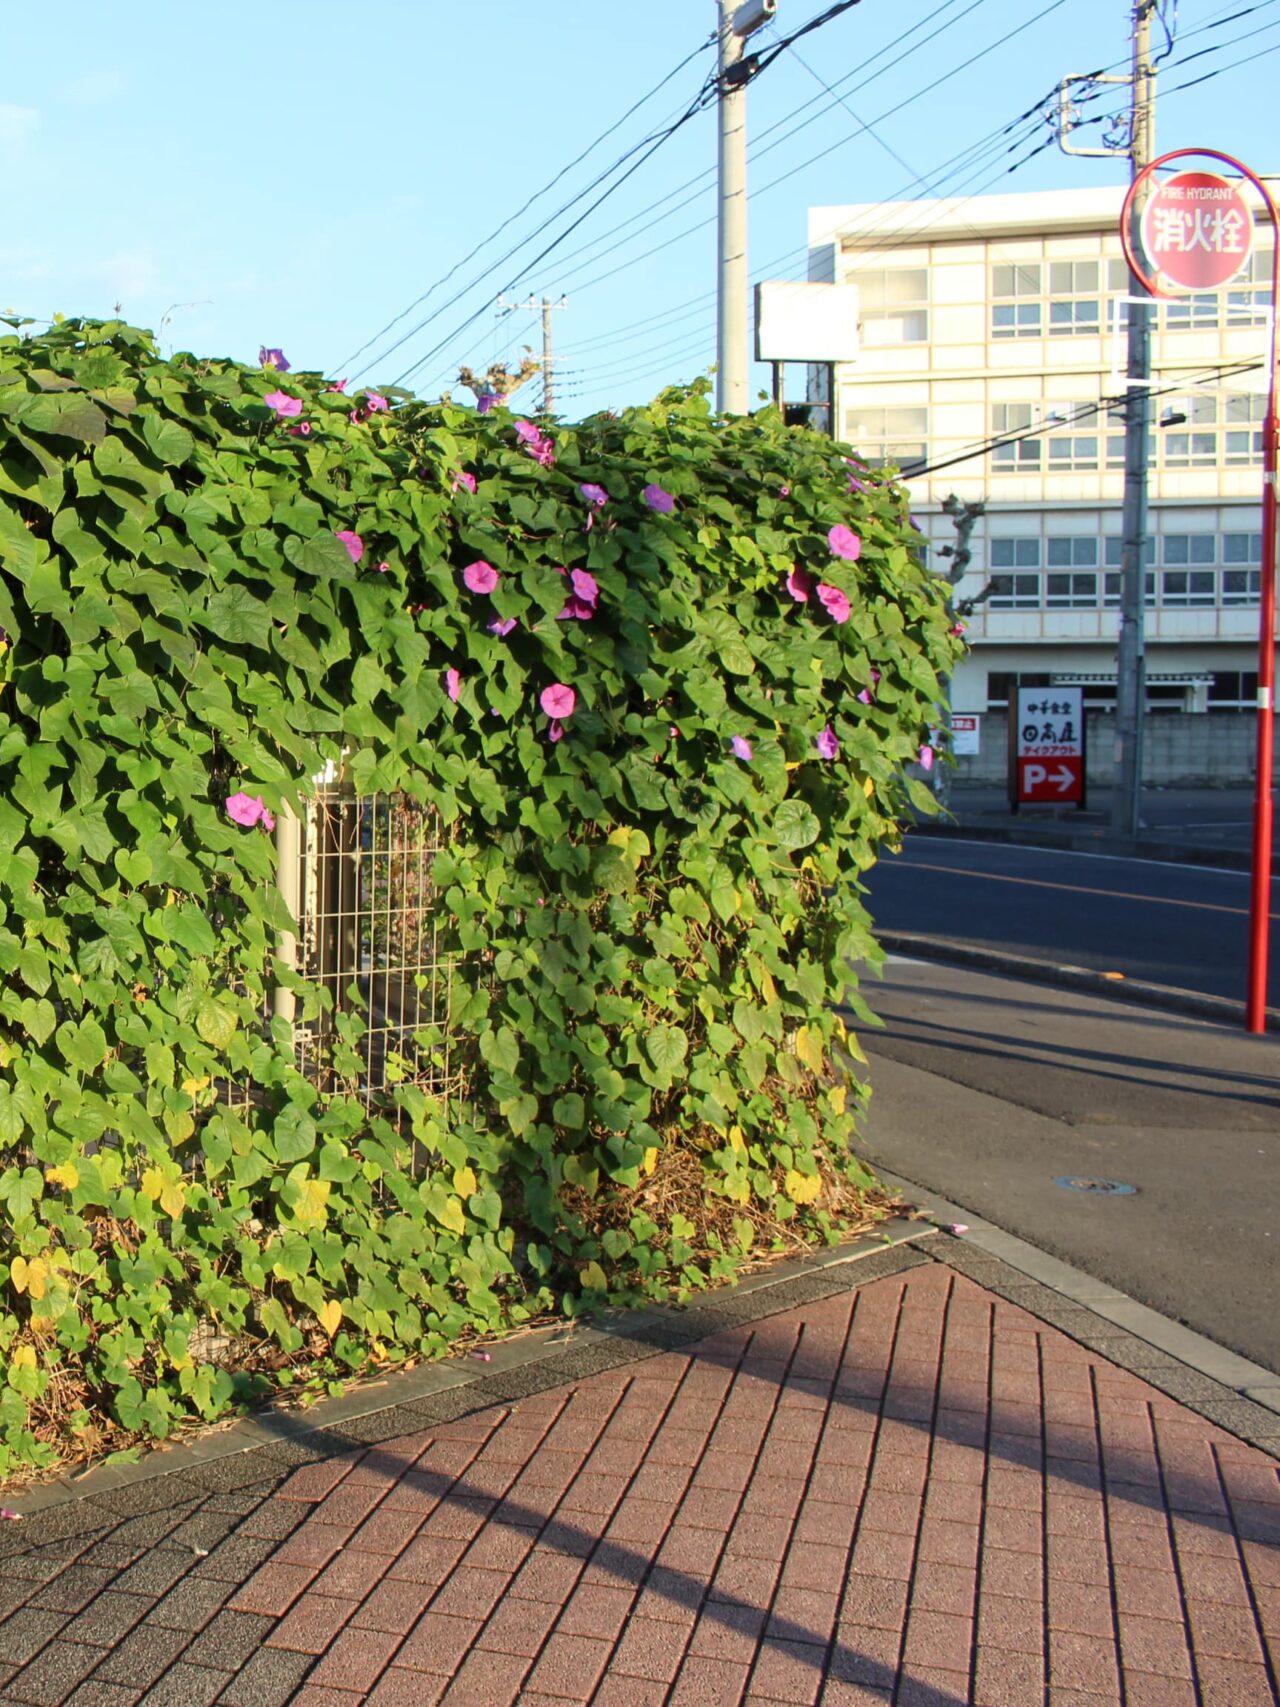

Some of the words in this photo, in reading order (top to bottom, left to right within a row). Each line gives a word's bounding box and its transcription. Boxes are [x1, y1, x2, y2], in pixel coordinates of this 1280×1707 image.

[1161, 188, 1184, 199] FIRE
[1187, 187, 1233, 200] HYDRANT
[1153, 208, 1244, 253] 消火栓
[1027, 699, 1072, 715] 中華食堂
[1022, 721, 1077, 743] 日高屋
[1024, 745, 1076, 755] テイクアウト
[1024, 764, 1046, 794] P
